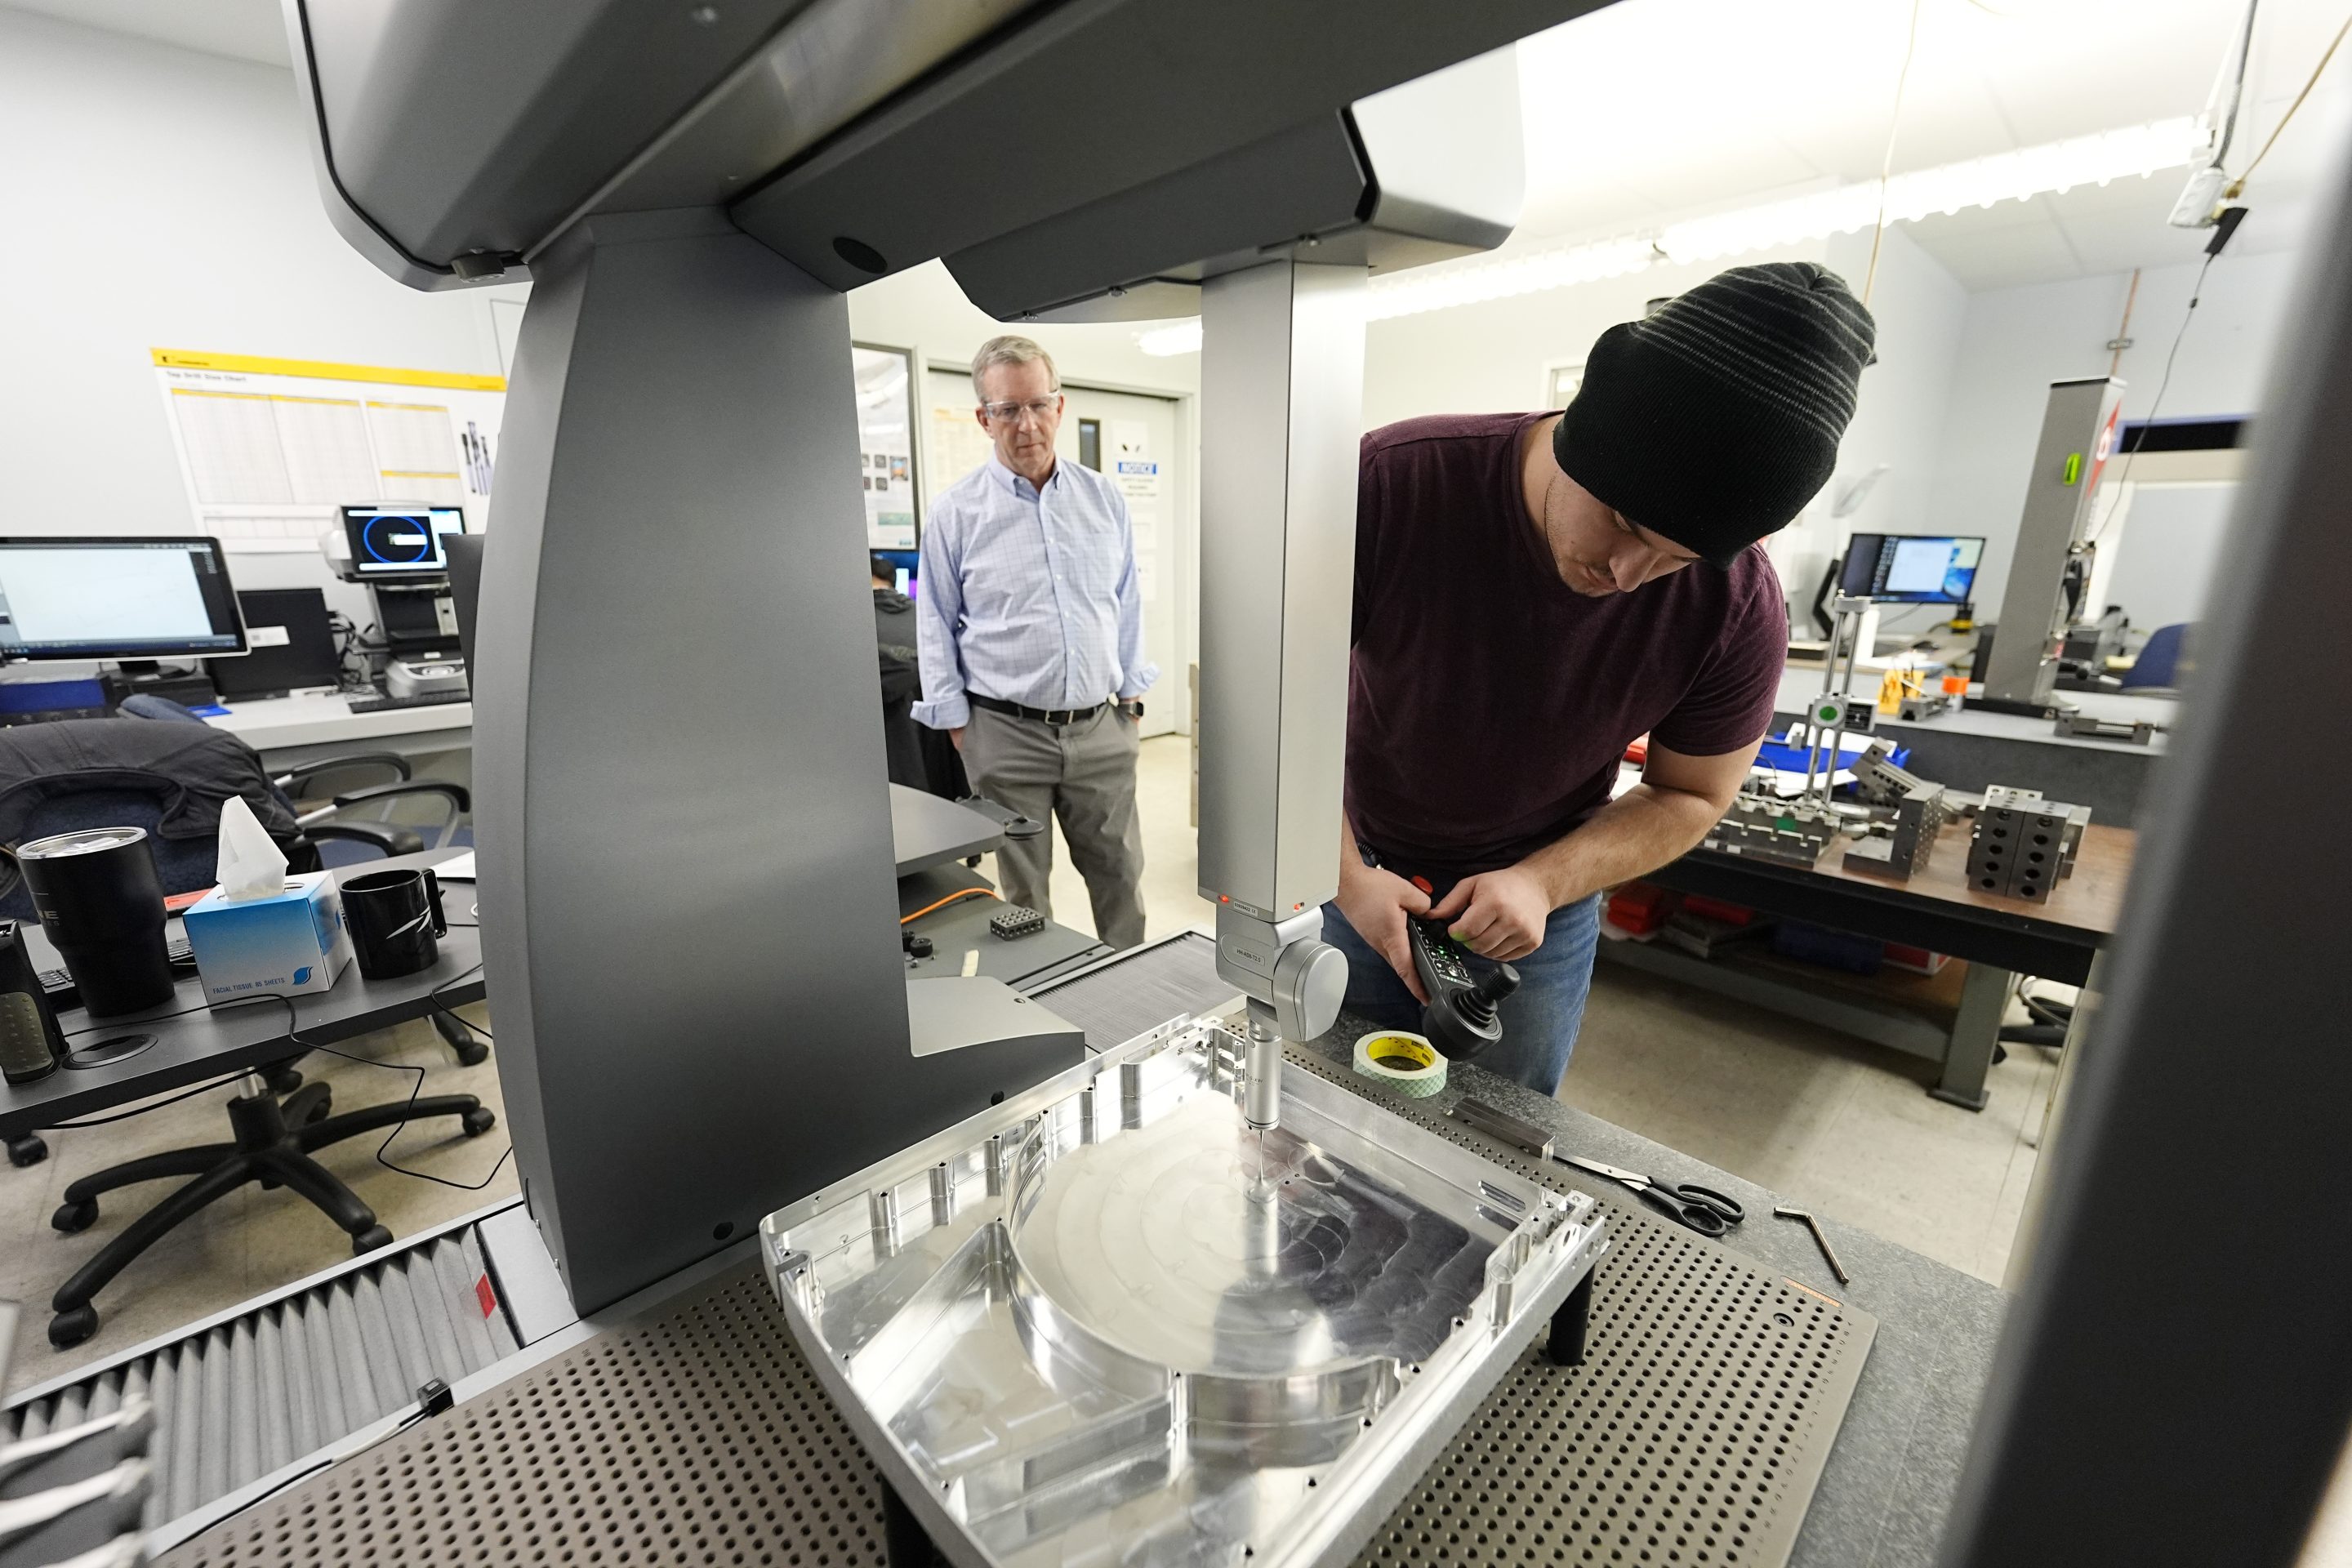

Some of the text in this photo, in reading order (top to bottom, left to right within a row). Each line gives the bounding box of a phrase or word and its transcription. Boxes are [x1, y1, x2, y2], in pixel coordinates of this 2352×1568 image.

[212, 986, 233, 994] FACIAL
[233, 982, 253, 991] TISSUE
[264, 978, 285, 986] SHEETS
